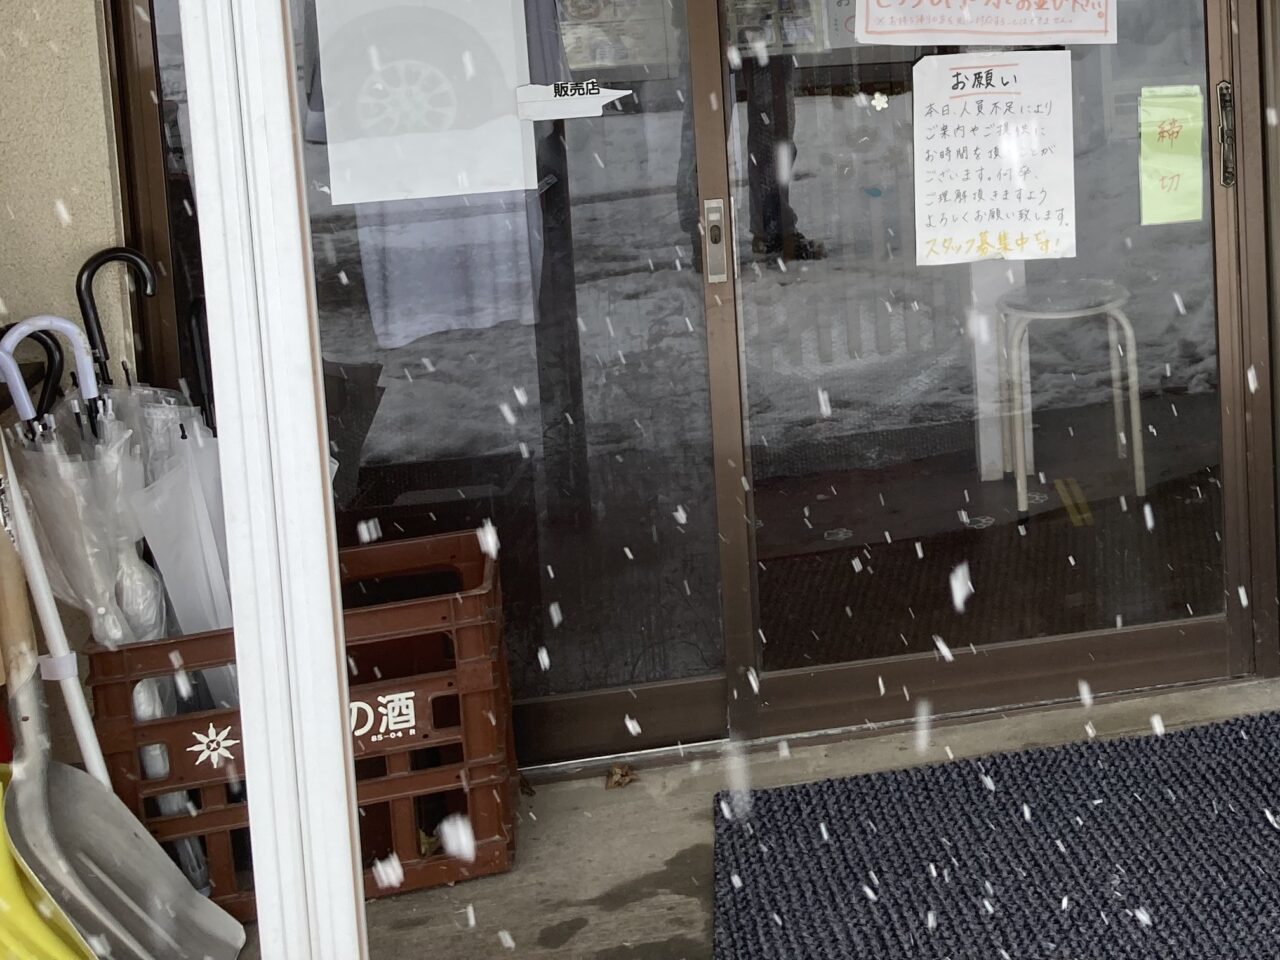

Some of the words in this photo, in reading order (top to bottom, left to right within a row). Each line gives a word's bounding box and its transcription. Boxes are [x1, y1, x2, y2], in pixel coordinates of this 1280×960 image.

[553, 80, 601, 98] 販売店
[951, 68, 1018, 91] お願い
[350, 690, 416, 737] の酒
[370, 730, 403, 742] 85-04
[409, 728, 416, 736] R
